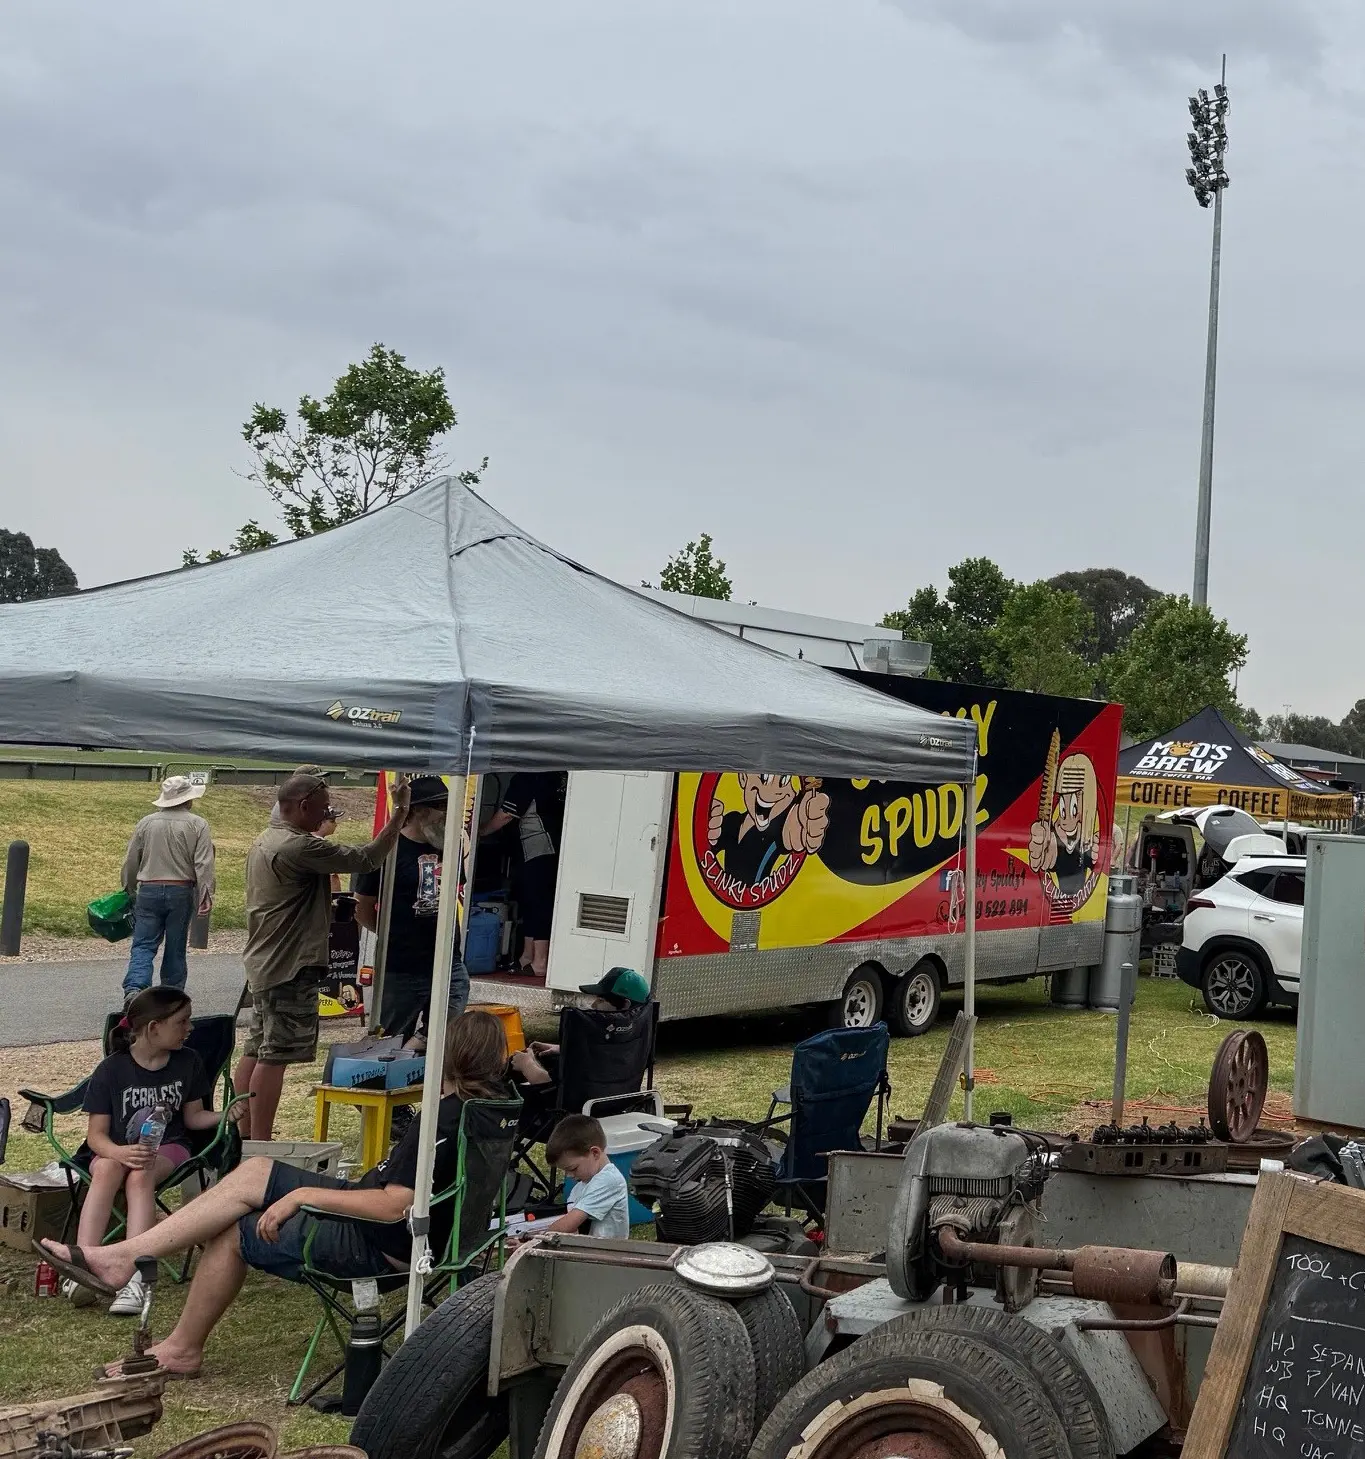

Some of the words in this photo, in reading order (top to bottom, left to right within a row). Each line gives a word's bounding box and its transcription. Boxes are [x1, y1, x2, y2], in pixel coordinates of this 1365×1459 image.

[347, 705, 402, 724] OZtrail
[1135, 755, 1225, 774] BREW
[1163, 771, 1193, 779] COFFEE
[1130, 782, 1193, 807] COFFEE
[1217, 789, 1280, 815] COFFEE
[700, 850, 747, 903] SLINKY
[750, 854, 800, 903] SPUDZ
[122, 1081, 182, 1118] FEARLESS
[1287, 1254, 1333, 1280] TOOL
[1258, 1386, 1290, 1415] HQ
[1306, 1370, 1365, 1406] P/VAN
[1254, 1417, 1285, 1447] HQ
